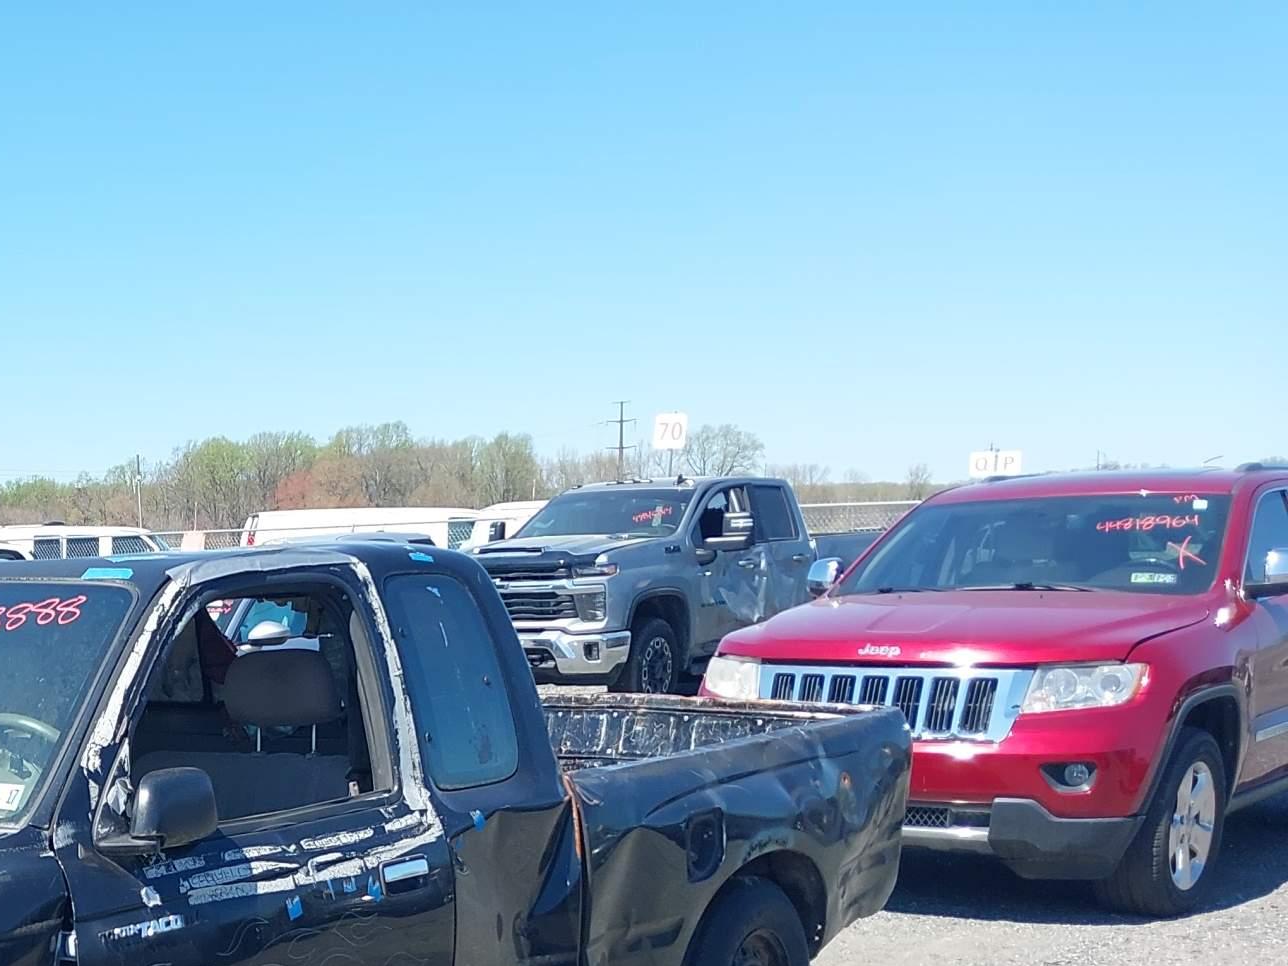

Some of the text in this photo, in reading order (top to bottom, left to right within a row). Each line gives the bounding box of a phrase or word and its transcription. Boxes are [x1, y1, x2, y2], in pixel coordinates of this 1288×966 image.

[658, 421, 684, 441] 70
[1003, 455, 1015, 471] P
[1095, 513, 1200, 533] 44818964
[857, 642, 902, 659] Jeep
